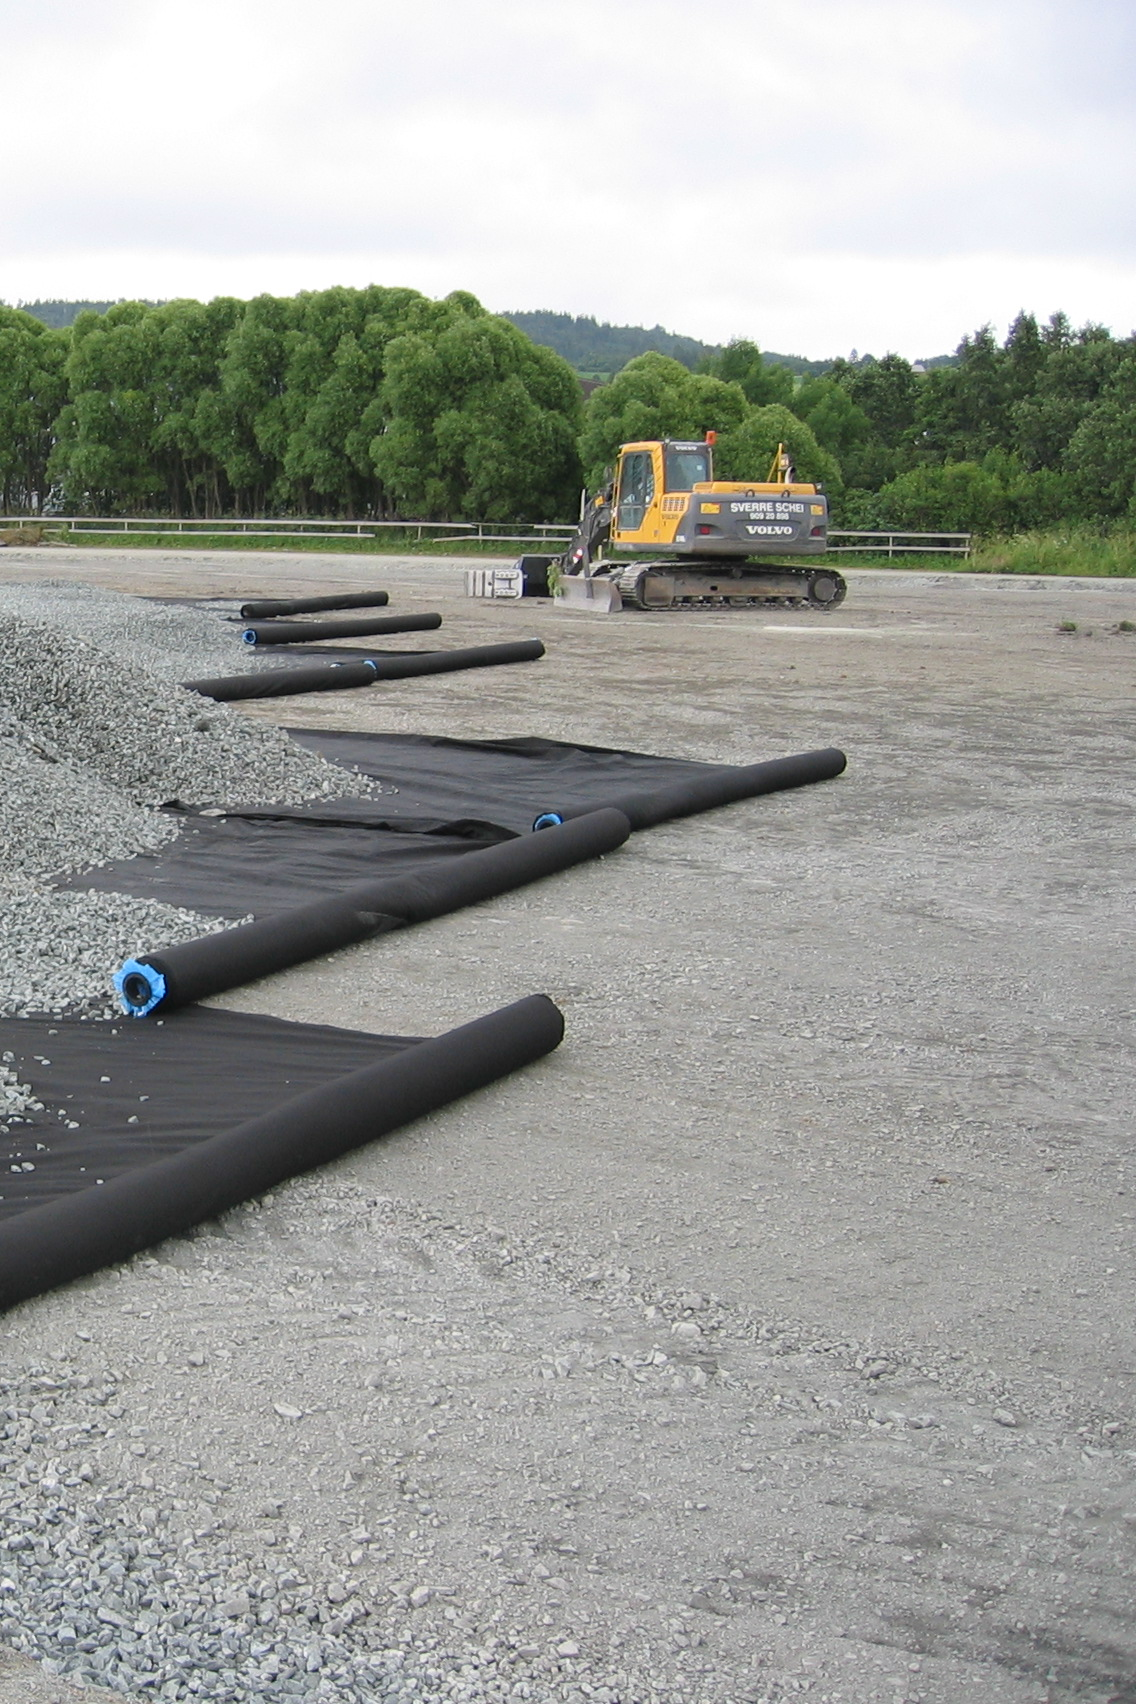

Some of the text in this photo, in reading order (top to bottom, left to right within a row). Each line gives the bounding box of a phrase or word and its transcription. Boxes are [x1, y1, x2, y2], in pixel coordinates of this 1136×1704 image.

[730, 502, 804, 513] SVERRE SCHEI
[745, 525, 793, 535] VOLVO
